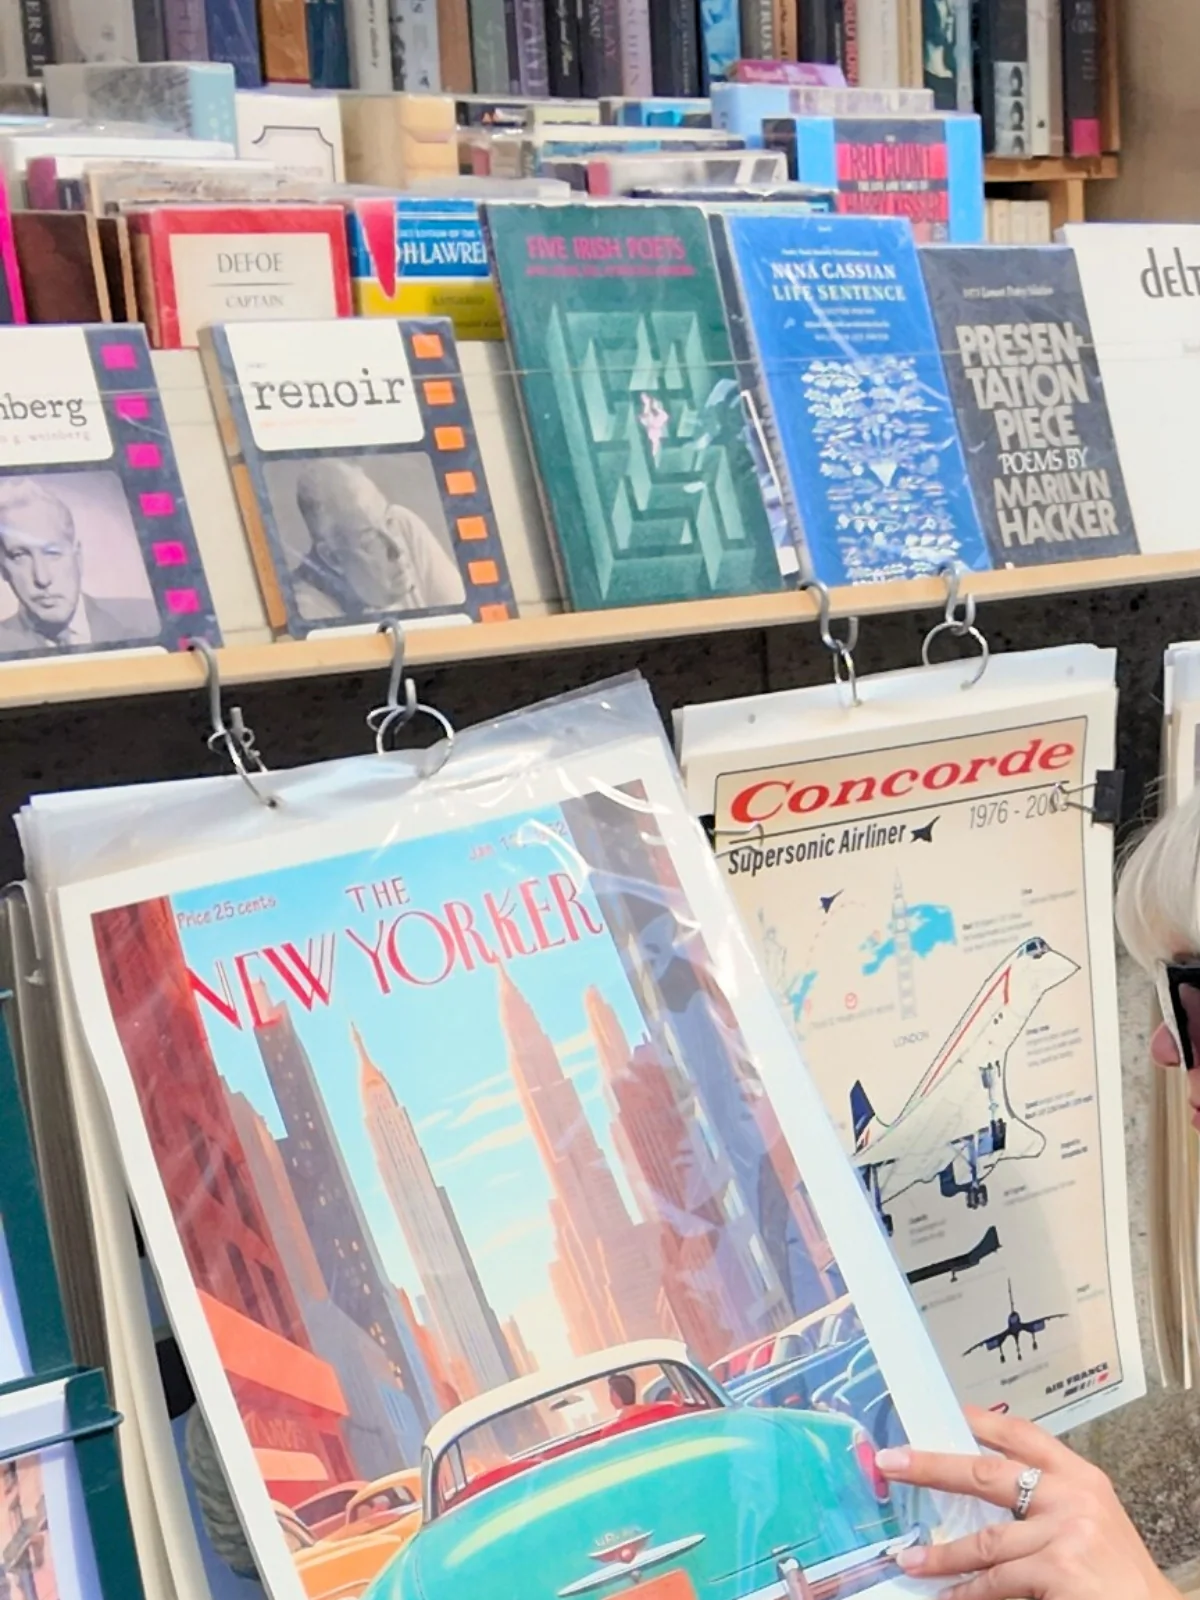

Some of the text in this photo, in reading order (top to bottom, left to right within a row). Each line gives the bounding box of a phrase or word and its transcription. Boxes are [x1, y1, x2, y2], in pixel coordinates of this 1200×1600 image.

[217, 251, 284, 274] DEFOE
[527, 235, 687, 260] FIVE IRISH POETS
[821, 261, 897, 280] CASSIAN
[225, 294, 284, 309] CAPTAIN
[772, 284, 907, 301] LIFE SENTENCE
[956, 322, 1084, 367] PRESEN-
[253, 367, 405, 411] renoir
[965, 364, 1089, 410] TATION
[994, 405, 1081, 450] PIECE
[998, 447, 1089, 475] POEMS BY
[993, 469, 1113, 510] MARILYN
[997, 500, 1119, 548] HACKER
[730, 738, 1076, 825] Concorde
[969, 800, 1009, 829] 1976
[728, 823, 907, 877] Supersonic Airliner
[177, 895, 277, 930] Price 25 cents
[345, 876, 411, 914] THE
[185, 872, 605, 1031] NEW YORKER
[893, 1030, 930, 1048] LONDON
[1045, 1380, 1064, 1395] AIR
[1066, 1362, 1109, 1386] FRANCE
